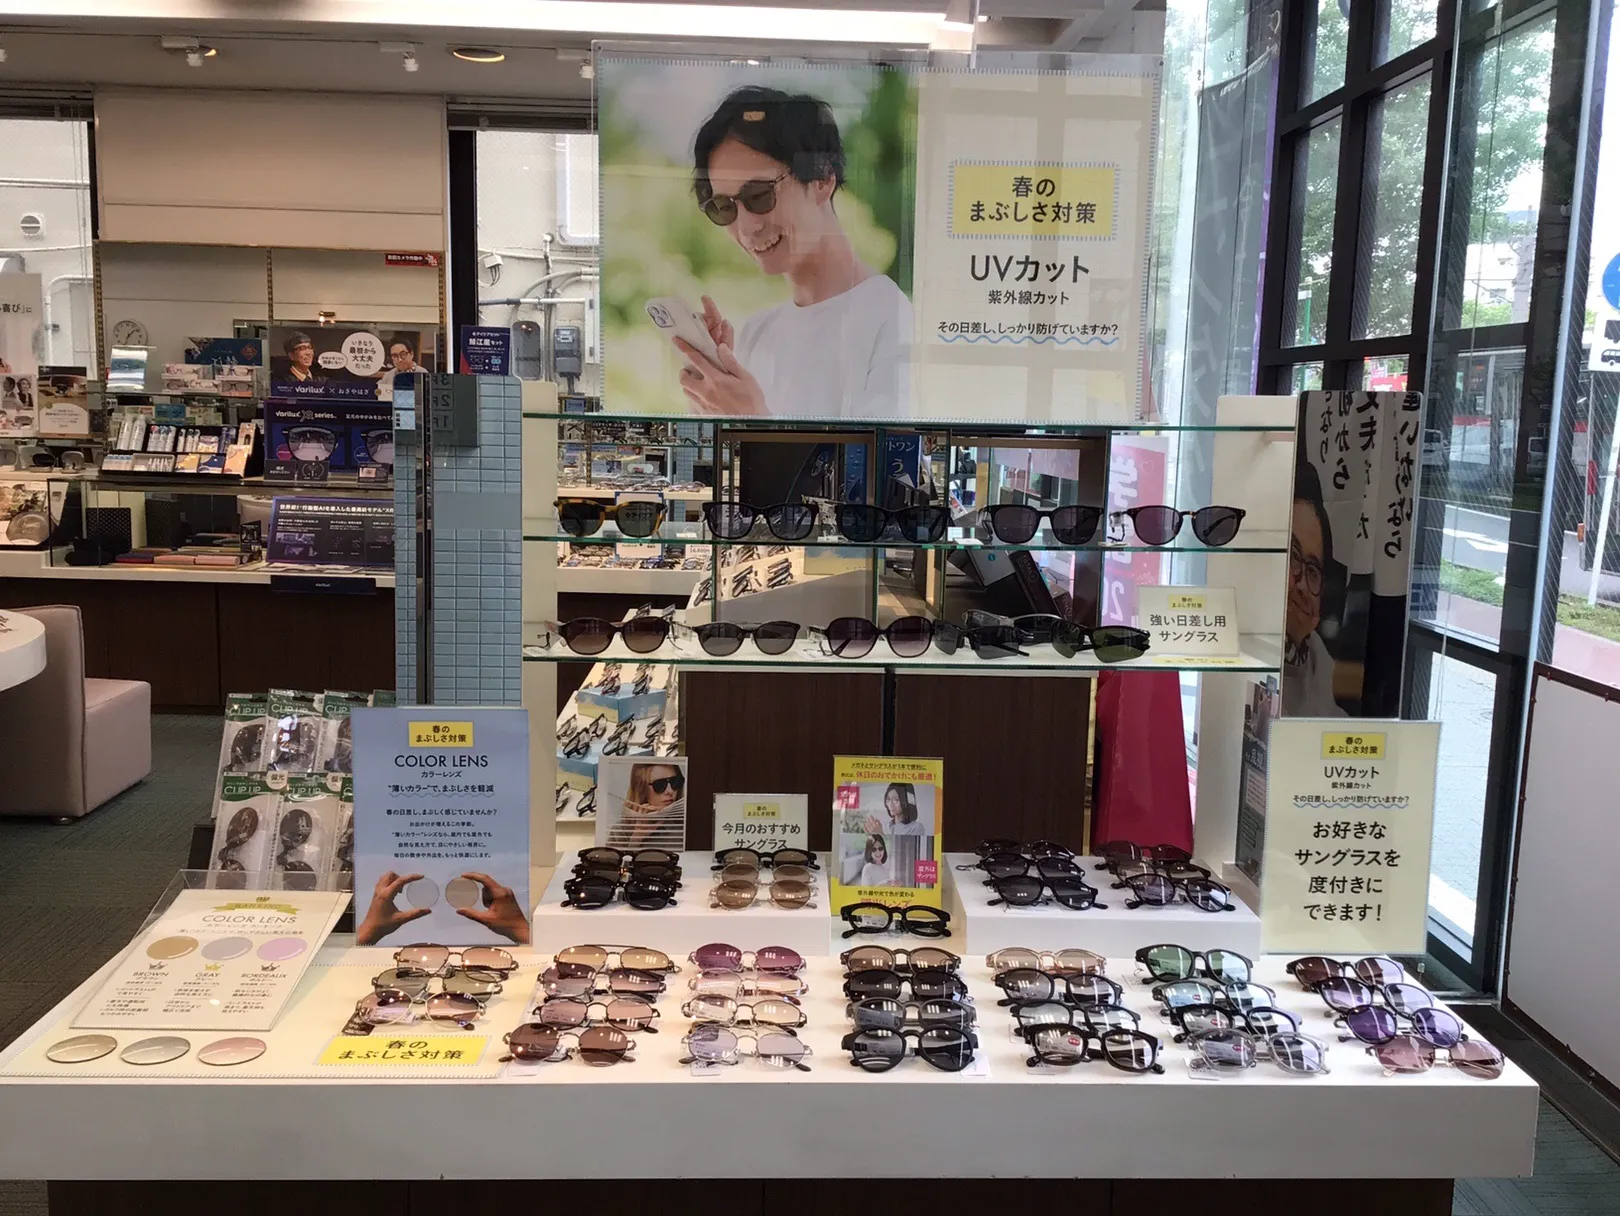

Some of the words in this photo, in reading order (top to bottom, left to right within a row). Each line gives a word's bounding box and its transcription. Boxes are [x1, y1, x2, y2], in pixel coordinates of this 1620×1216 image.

[1011, 175, 1057, 197] 春の
[969, 201, 1097, 224] まぶしさ対策
[970, 255, 1090, 284] UVカット
[987, 289, 1070, 306] 紫外線カット
[0, 303, 33, 314] 喜び」に
[937, 320, 1119, 337] その日差し、しっかり防げていますか?
[351, 339, 374, 347] いきなり
[349, 347, 377, 355] 最初から
[351, 355, 375, 363] 大丈夫
[354, 362, 372, 370] だった
[1149, 614, 1227, 628] 強い日差し用
[1158, 630, 1219, 643] サングラス
[431, 724, 451, 734] 春の
[415, 733, 468, 743] まぶしさ対策
[1345, 736, 1363, 745] 春の
[1328, 745, 1379, 755] まぶしさ対策
[394, 754, 447, 768] COLOR
[452, 754, 489, 768] LENS
[420, 770, 462, 779] カラーレンズ
[1323, 765, 1380, 780] UVカット
[1331, 781, 1372, 789] 紫外線カット
[1293, 795, 1410, 804] その日差し、しっかり防げていますか?
[386, 808, 498, 817] 春の日差し、まぶしく感じていませんか?
[721, 822, 802, 836] 今月のおすすめ
[1312, 820, 1388, 840] お好きな
[734, 839, 788, 850] サングラス
[1294, 848, 1402, 868] サングラスを
[1307, 875, 1384, 895] 度付きに
[1303, 903, 1383, 922] できます!
[202, 914, 256, 924] COLOR
[258, 915, 298, 925] LENS
[385, 1039, 429, 1050] 春の
[338, 1050, 465, 1061] まぶしさ対策
